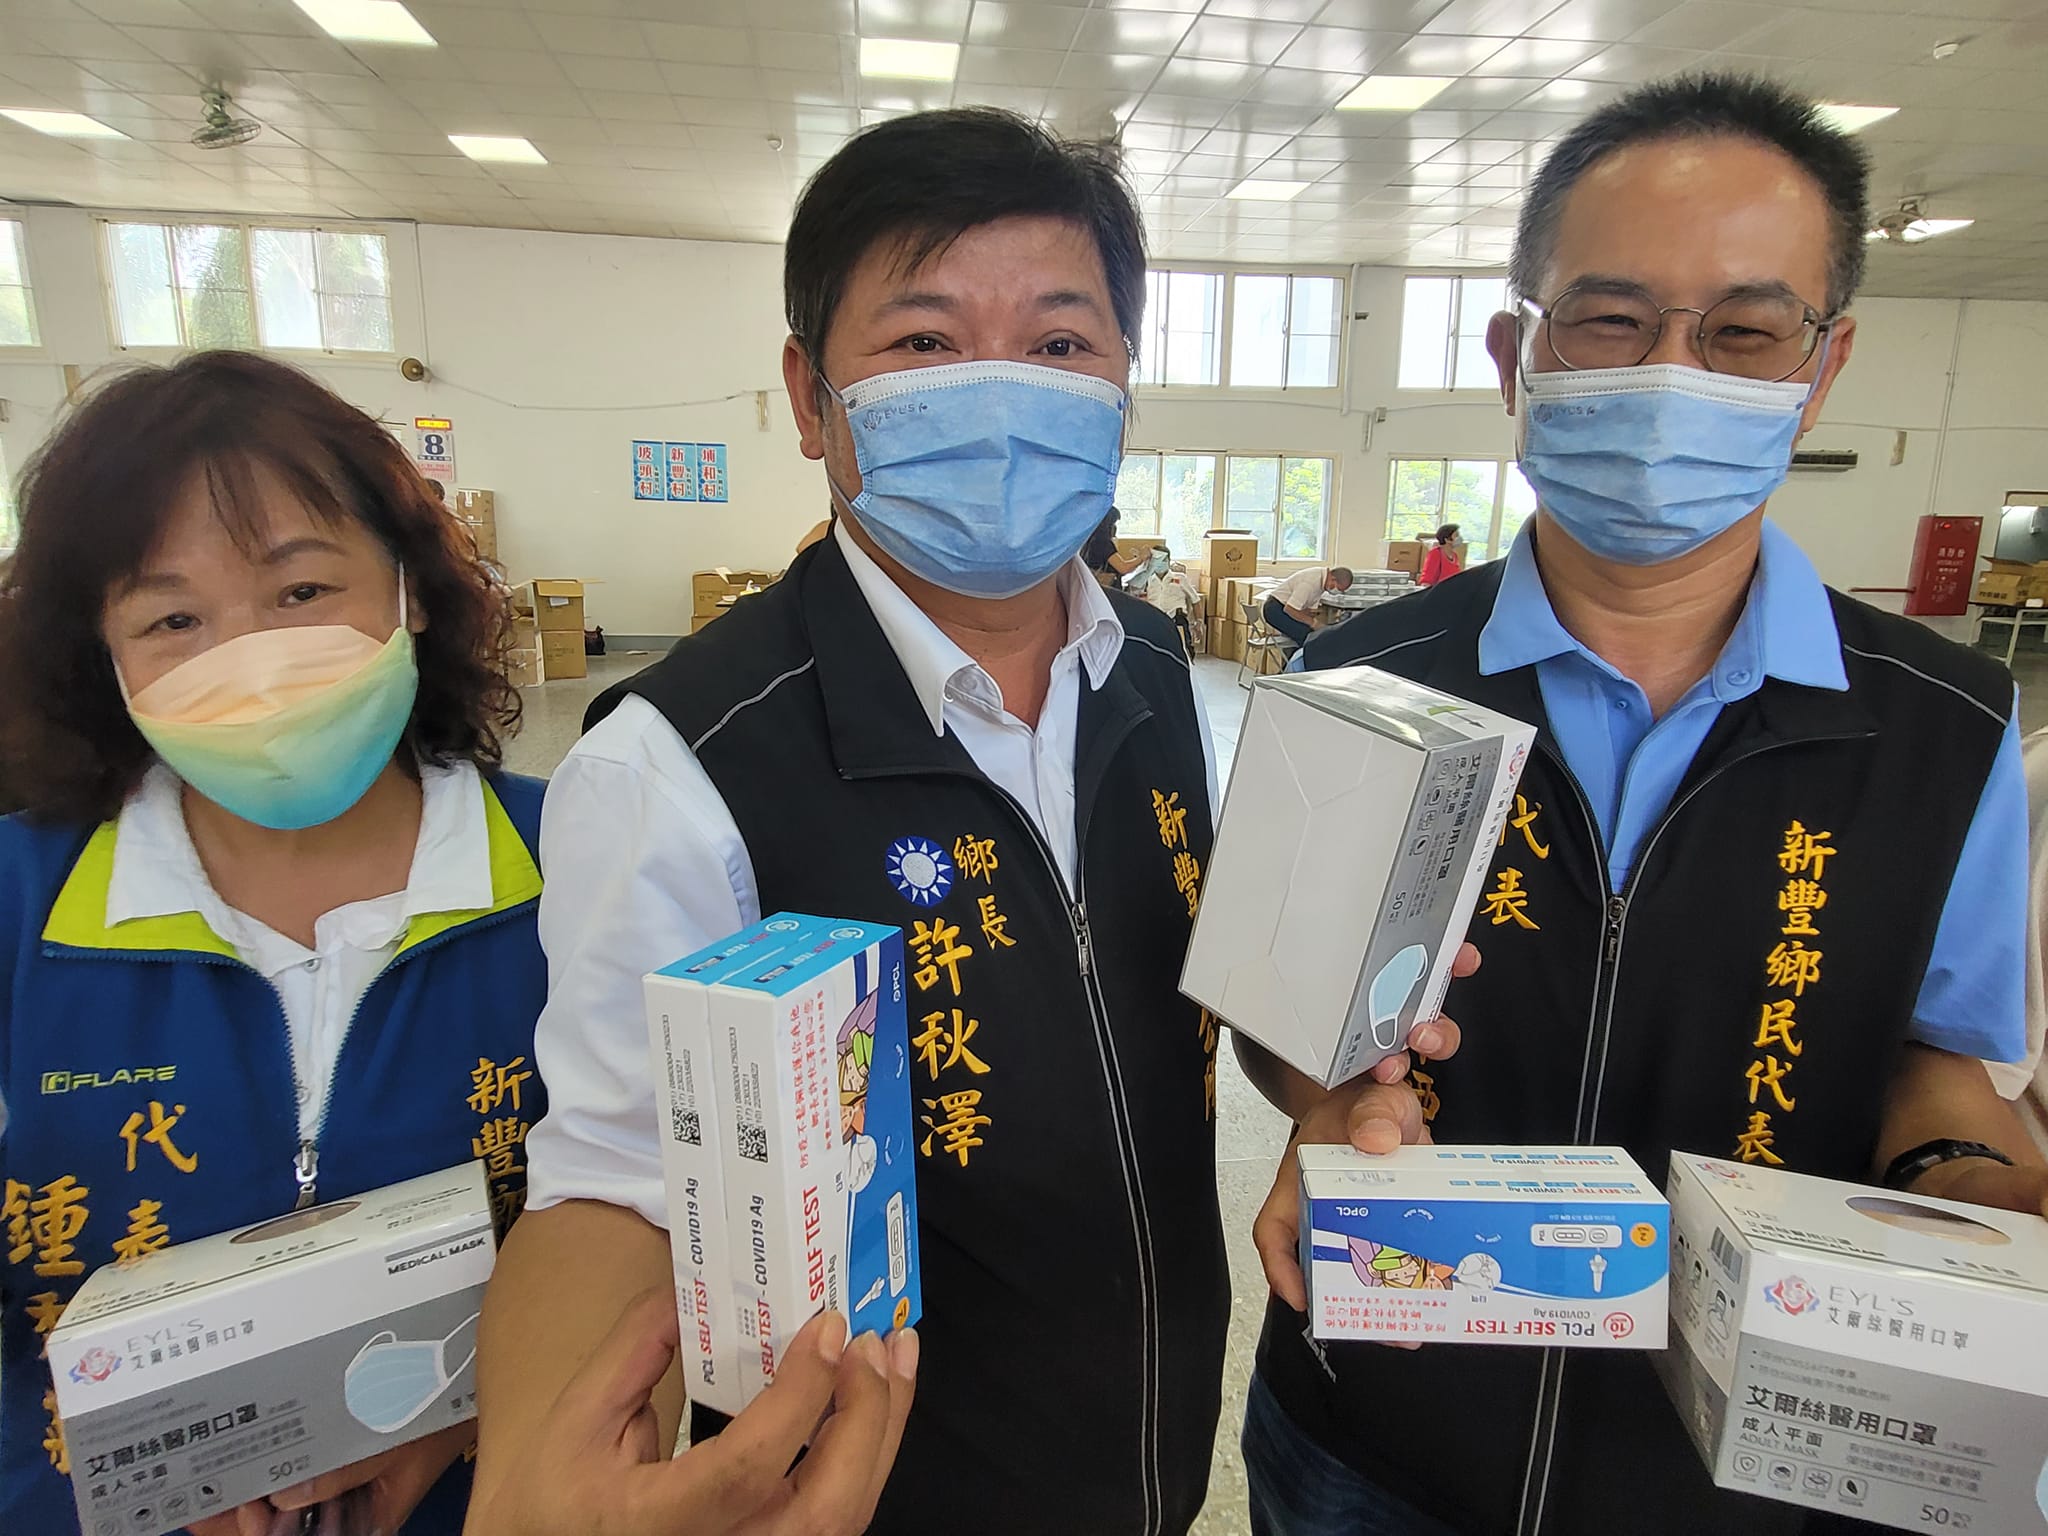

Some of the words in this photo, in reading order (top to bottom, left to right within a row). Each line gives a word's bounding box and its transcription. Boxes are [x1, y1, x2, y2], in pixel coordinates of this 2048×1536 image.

[425, 434, 444, 455] 8
[638, 446, 653, 495] 坡頭村
[671, 447, 686, 496] 新豐村
[1480, 793, 1549, 931] 代表
[953, 833, 1018, 950] 鄉長
[1733, 820, 1838, 1166] 新豐鄉民代表
[908, 917, 993, 1168] 許秋澤
[71, 1065, 177, 1090] FLARE
[686, 1178, 699, 1199] Ag
[750, 1195, 764, 1217] Ag
[685, 1201, 704, 1266] COVID19
[803, 1185, 821, 1246] TEST
[387, 1249, 447, 1276] MEDICAL
[447, 1236, 488, 1260] MASK
[750, 1218, 767, 1286] COVID19
[808, 1248, 826, 1303] SELF
[694, 1279, 709, 1316] TEST
[1533, 1307, 1546, 1319] Ag
[1546, 1309, 1591, 1320] COVID19
[1829, 1285, 1916, 1317] EYL'S
[126, 1319, 206, 1354] EYL'S
[698, 1317, 712, 1355] SELF
[757, 1299, 772, 1337] TEST
[1464, 1319, 1509, 1334] TEST
[1513, 1320, 1556, 1336] SELF
[1562, 1322, 1595, 1337] PCL
[1610, 1322, 1628, 1334] 10
[1826, 1306, 1970, 1351] 艾爾絲醫用口罩
[131, 1319, 256, 1372] 艾爾絲醫用口罩
[761, 1338, 776, 1378] SELF
[703, 1359, 716, 1385] PCL
[1742, 1416, 1824, 1448] 成人平面
[1745, 1384, 1938, 1446] 艾爾絲醫用口罩
[85, 1403, 260, 1477] 艾爾絲醫用口罩
[1739, 1432, 1781, 1452] ADULT
[1783, 1442, 1820, 1459] MASK
[268, 1461, 293, 1484] 50
[1919, 1503, 1950, 1525] 50
